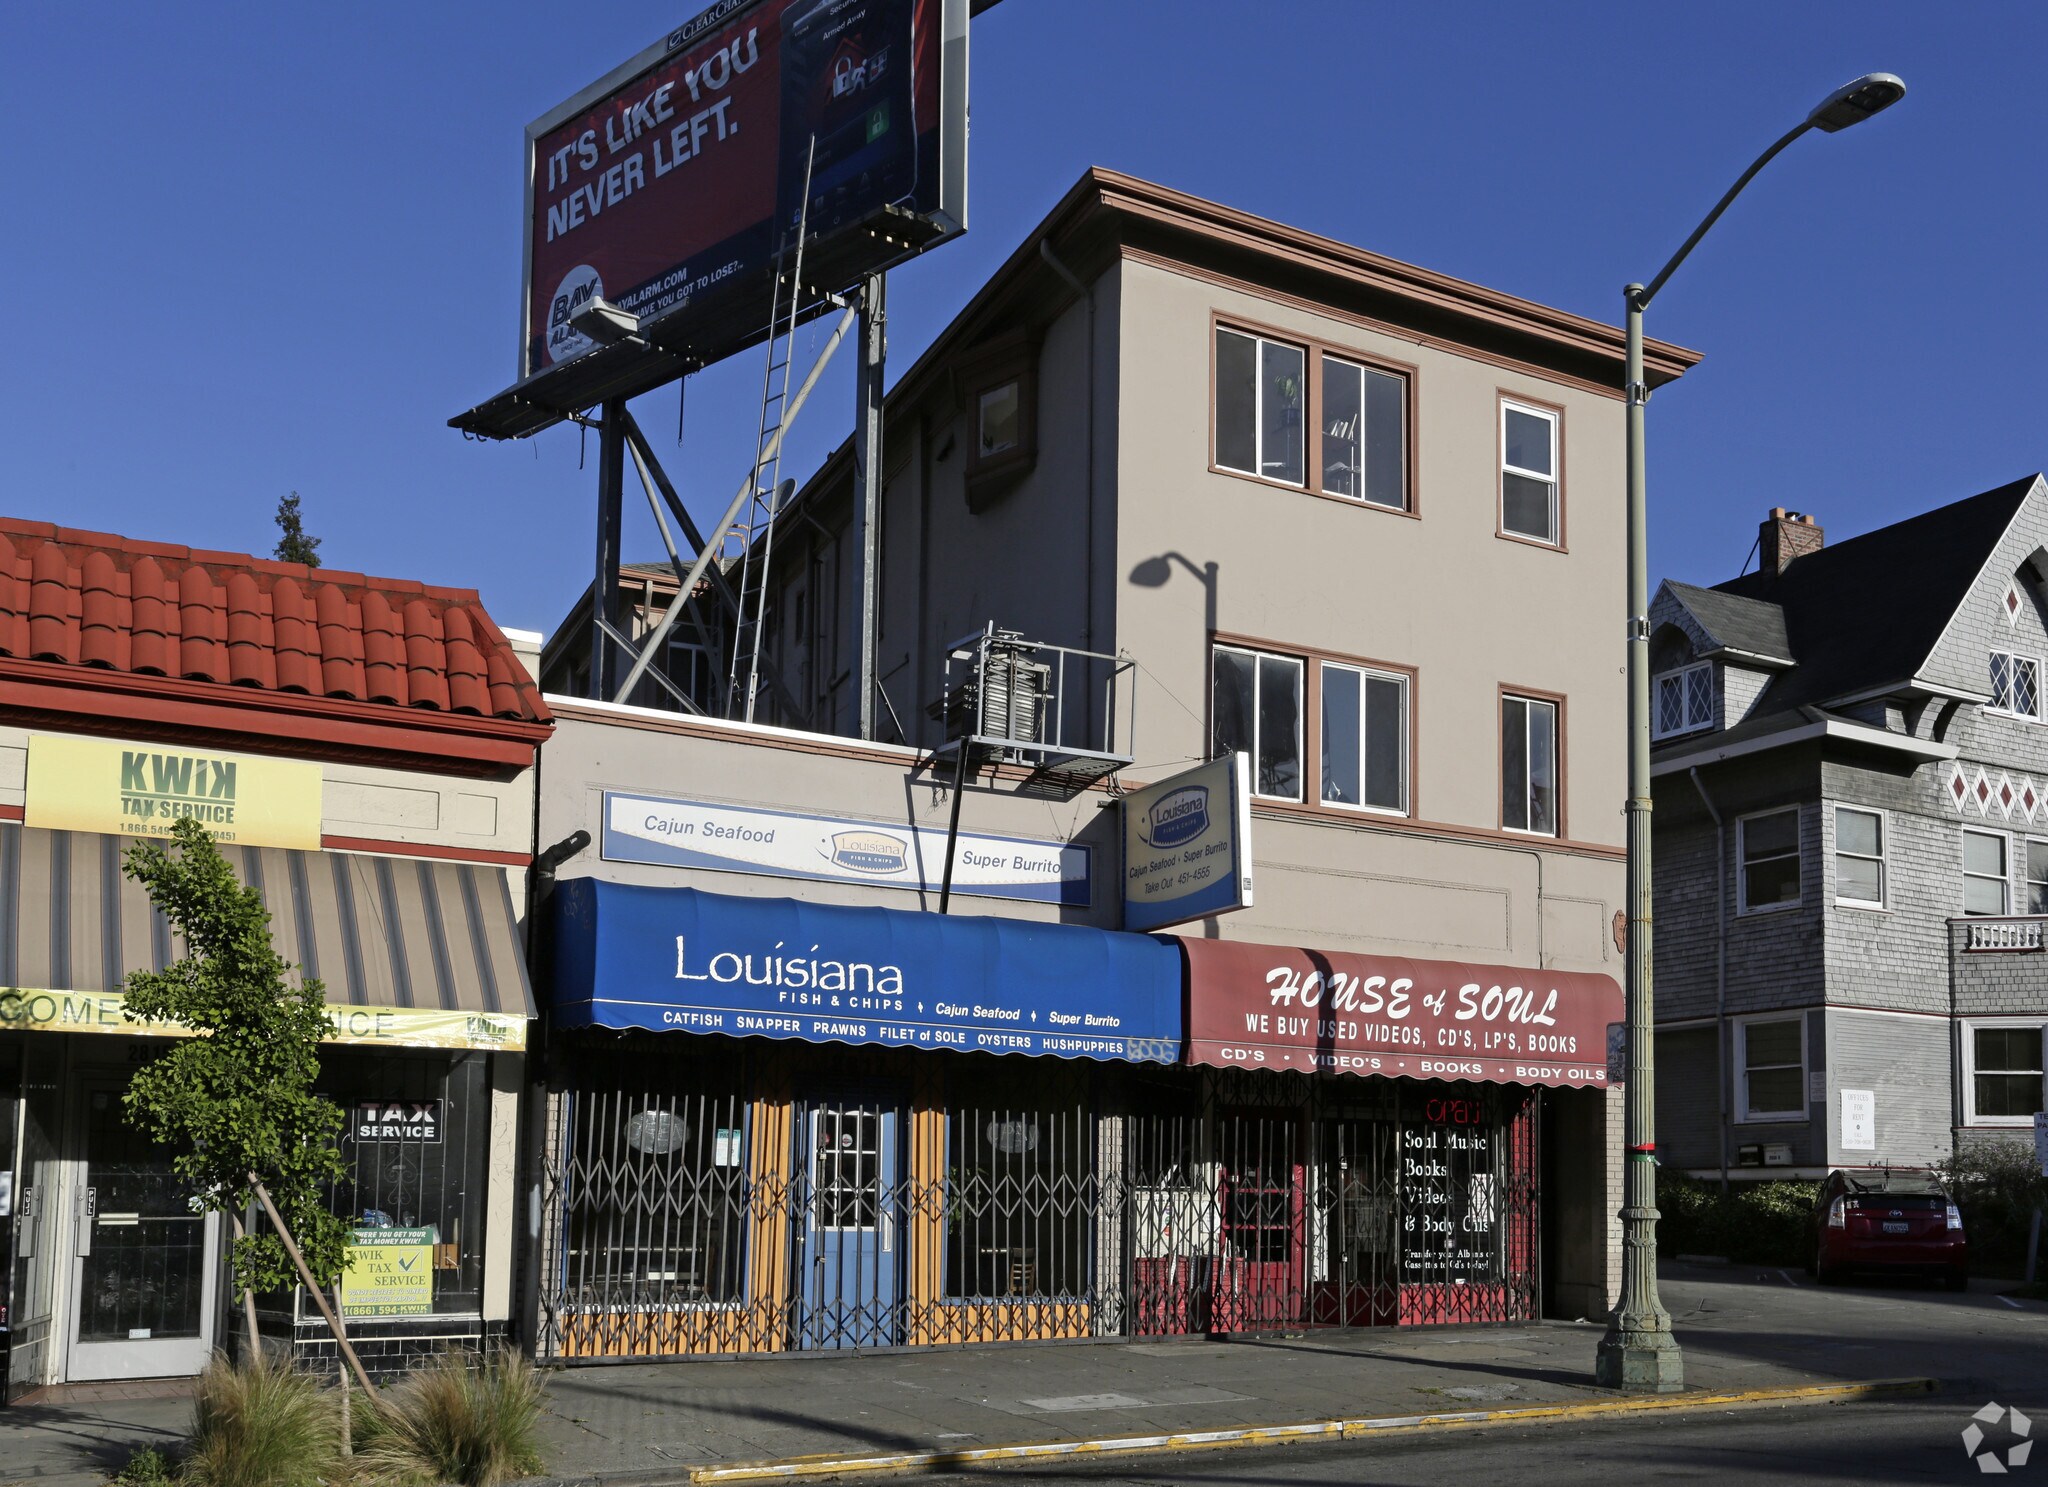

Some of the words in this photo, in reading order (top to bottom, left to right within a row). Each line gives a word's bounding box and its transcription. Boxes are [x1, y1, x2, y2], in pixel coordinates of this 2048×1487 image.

[822, 20, 846, 41] Armed
[846, 8, 866, 27] Away
[548, 129, 599, 192] IT'S
[605, 80, 675, 154] LIKE
[685, 26, 759, 102] YOU
[547, 152, 645, 243] NEVER
[653, 96, 738, 179] LEFT.
[657, 293, 675, 310] YOU
[676, 281, 695, 300] GOT
[697, 275, 709, 291] TO
[120, 797, 155, 817] TAX
[160, 801, 235, 824] SERVICE
[1156, 797, 1203, 825] Louisiana
[644, 815, 695, 836] Cajun
[702, 821, 775, 844] Seafood
[842, 838, 900, 855] Louisiana
[962, 850, 1007, 869] Super
[1012, 856, 1062, 874] Burrito
[1129, 866, 1148, 879] Cajun
[1149, 855, 1176, 873] Seafood
[1183, 849, 1204, 864] Super
[1205, 840, 1228, 857] Burrito
[1144, 882, 1159, 895] Take
[1160, 877, 1174, 890] Out
[675, 935, 904, 996] Louisiana
[1266, 966, 1413, 1020] HOUSE
[1422, 988, 1447, 1017] of
[1454, 983, 1558, 1027] SOUL
[778, 991, 822, 1005] FISH
[831, 995, 841, 1007] &
[849, 997, 903, 1011] CHIPS
[935, 1003, 969, 1018] Cajun
[972, 1005, 1020, 1021] Seafood
[1049, 1011, 1081, 1026] Super
[1084, 1013, 1120, 1028] Burrito
[663, 1011, 723, 1027] CATFISH
[736, 1016, 800, 1032] SNAPPER
[813, 1022, 867, 1037] PRAWNS
[879, 1027, 915, 1041] FILET
[919, 1029, 931, 1042] of
[934, 1031, 966, 1044] SOLE
[977, 1034, 1031, 1048] OYSTERS
[1043, 1038, 1123, 1054] HUSHPUPPIES
[1245, 1013, 1269, 1034] WE
[1277, 1016, 1309, 1036] BUY
[1316, 1019, 1358, 1040] USED
[1365, 1023, 1426, 1048] VIDEOS,
[1437, 1028, 1477, 1051] CD'S,
[1484, 1031, 1521, 1054] LP'S,
[1528, 1034, 1577, 1054] BOOKS
[1220, 1046, 1265, 1062] CD'S
[1308, 1053, 1382, 1069] VIDEO'S
[1420, 1060, 1483, 1075] BOOKS
[1515, 1066, 1562, 1079] BODY
[1567, 1068, 1606, 1081] OILS
[1847, 1094, 1869, 1102] OFFICES
[1853, 1103, 1863, 1111] FOR
[360, 1102, 435, 1123] TAX
[1852, 1113, 1865, 1121] RENT
[359, 1125, 435, 1138] SERVICE
[1405, 1130, 1438, 1149] Soul
[1444, 1132, 1487, 1150] Music
[1405, 1158, 1447, 1177] Books
[1404, 1214, 1415, 1232] &
[1423, 1214, 1455, 1235] Body
[367, 1263, 392, 1273] TAX
[374, 1275, 426, 1286] SERVICE
[343, 1307, 375, 1316] 1(866)
